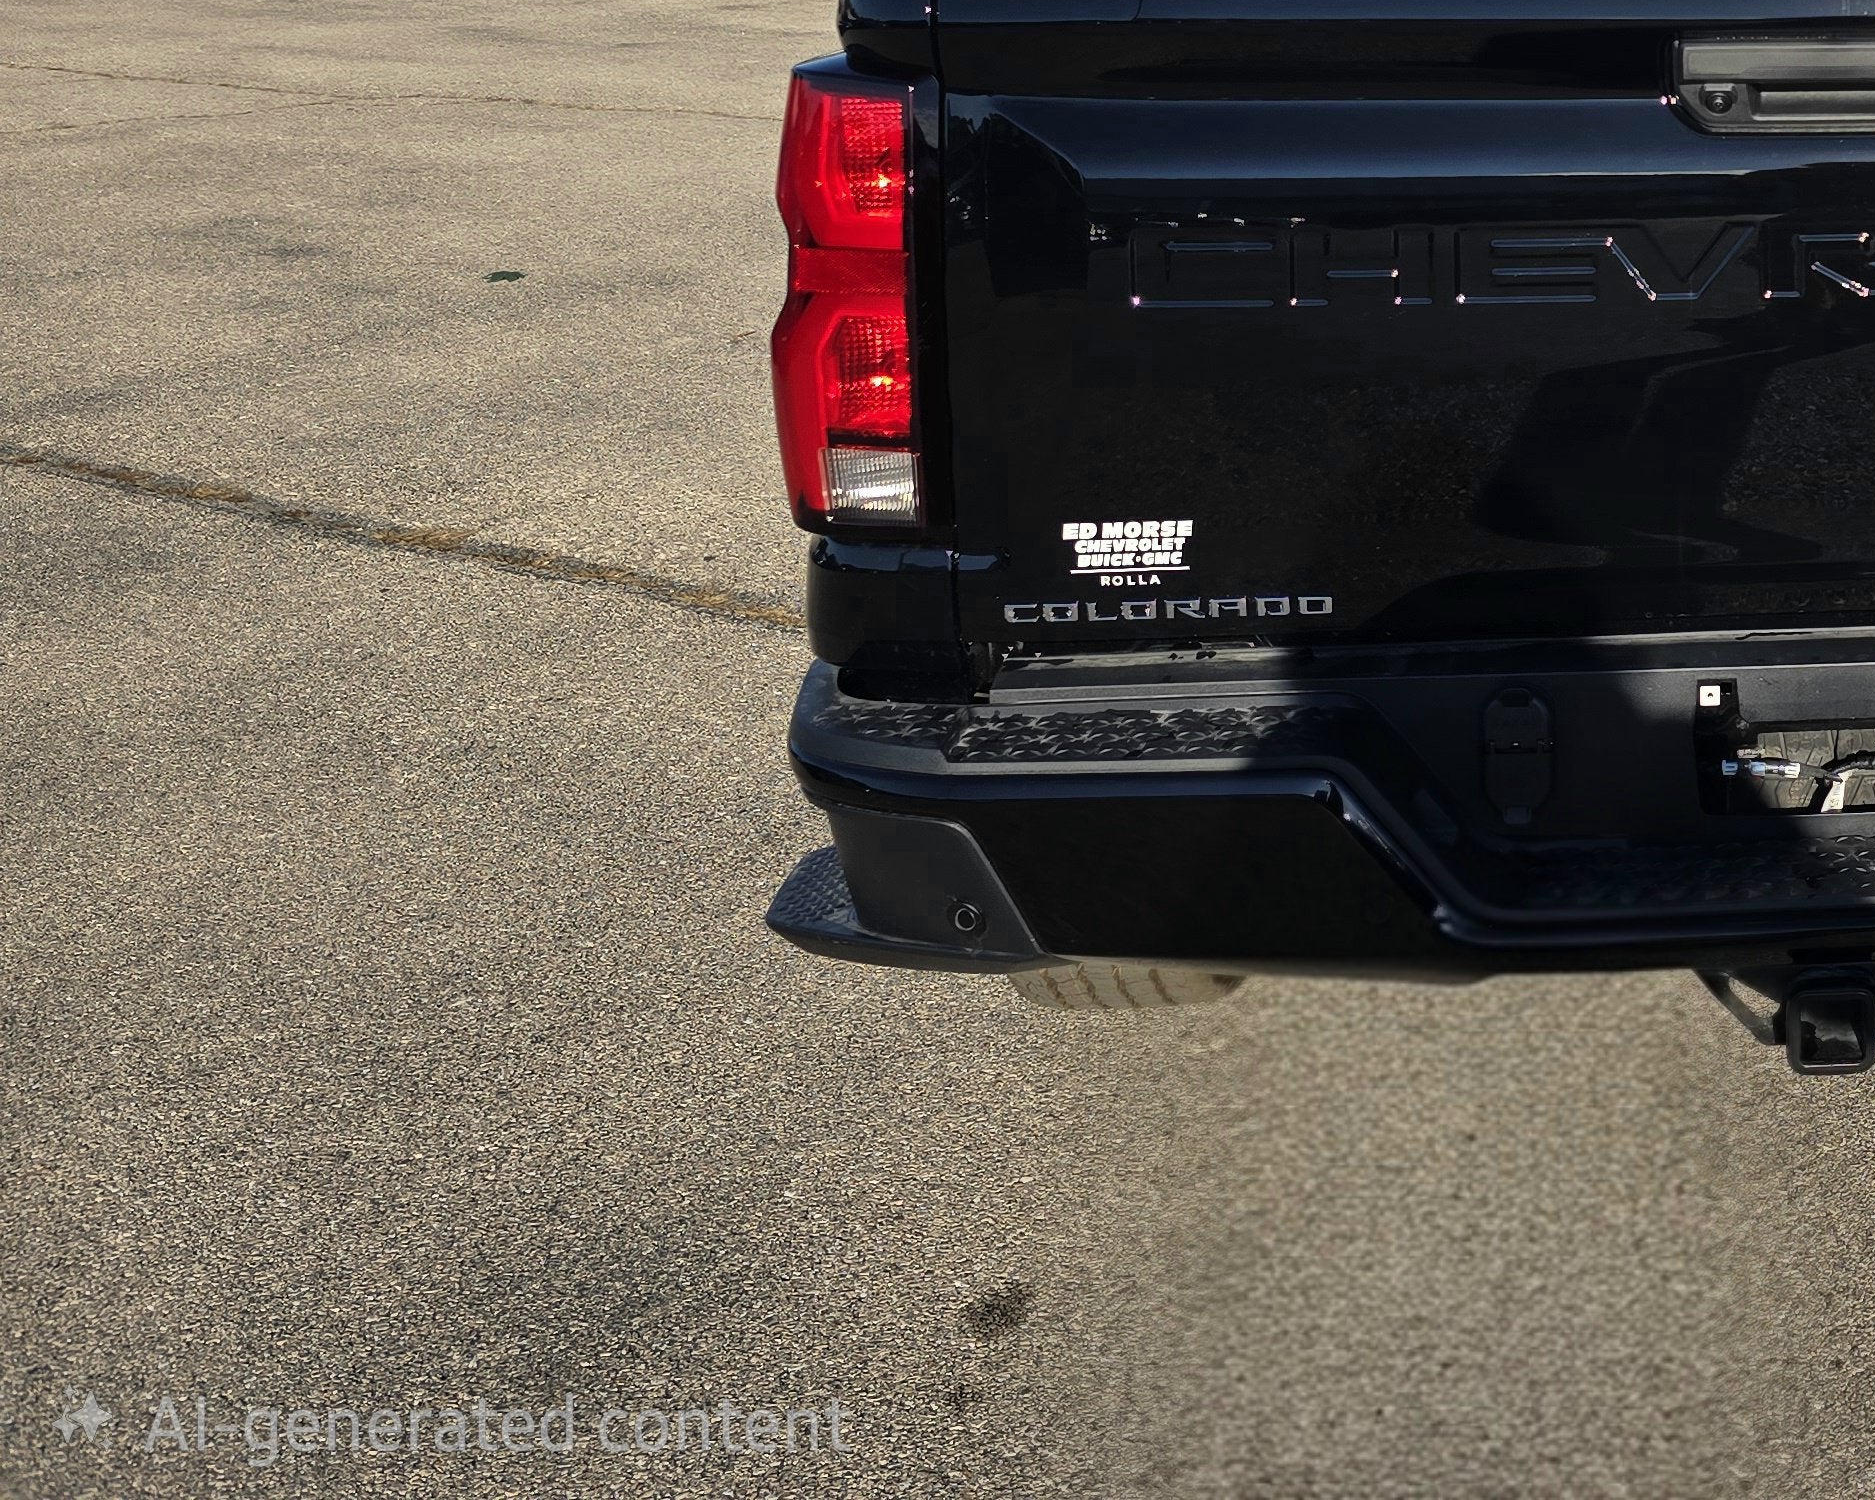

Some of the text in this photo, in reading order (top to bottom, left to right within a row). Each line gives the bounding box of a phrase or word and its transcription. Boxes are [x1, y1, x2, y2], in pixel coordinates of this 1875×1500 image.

[1062, 520, 1194, 541] ED MORSE
[1073, 537, 1186, 554] CHEVROLET
[1100, 574, 1162, 587] ROLLA
[1003, 596, 1333, 623] COLORADO
